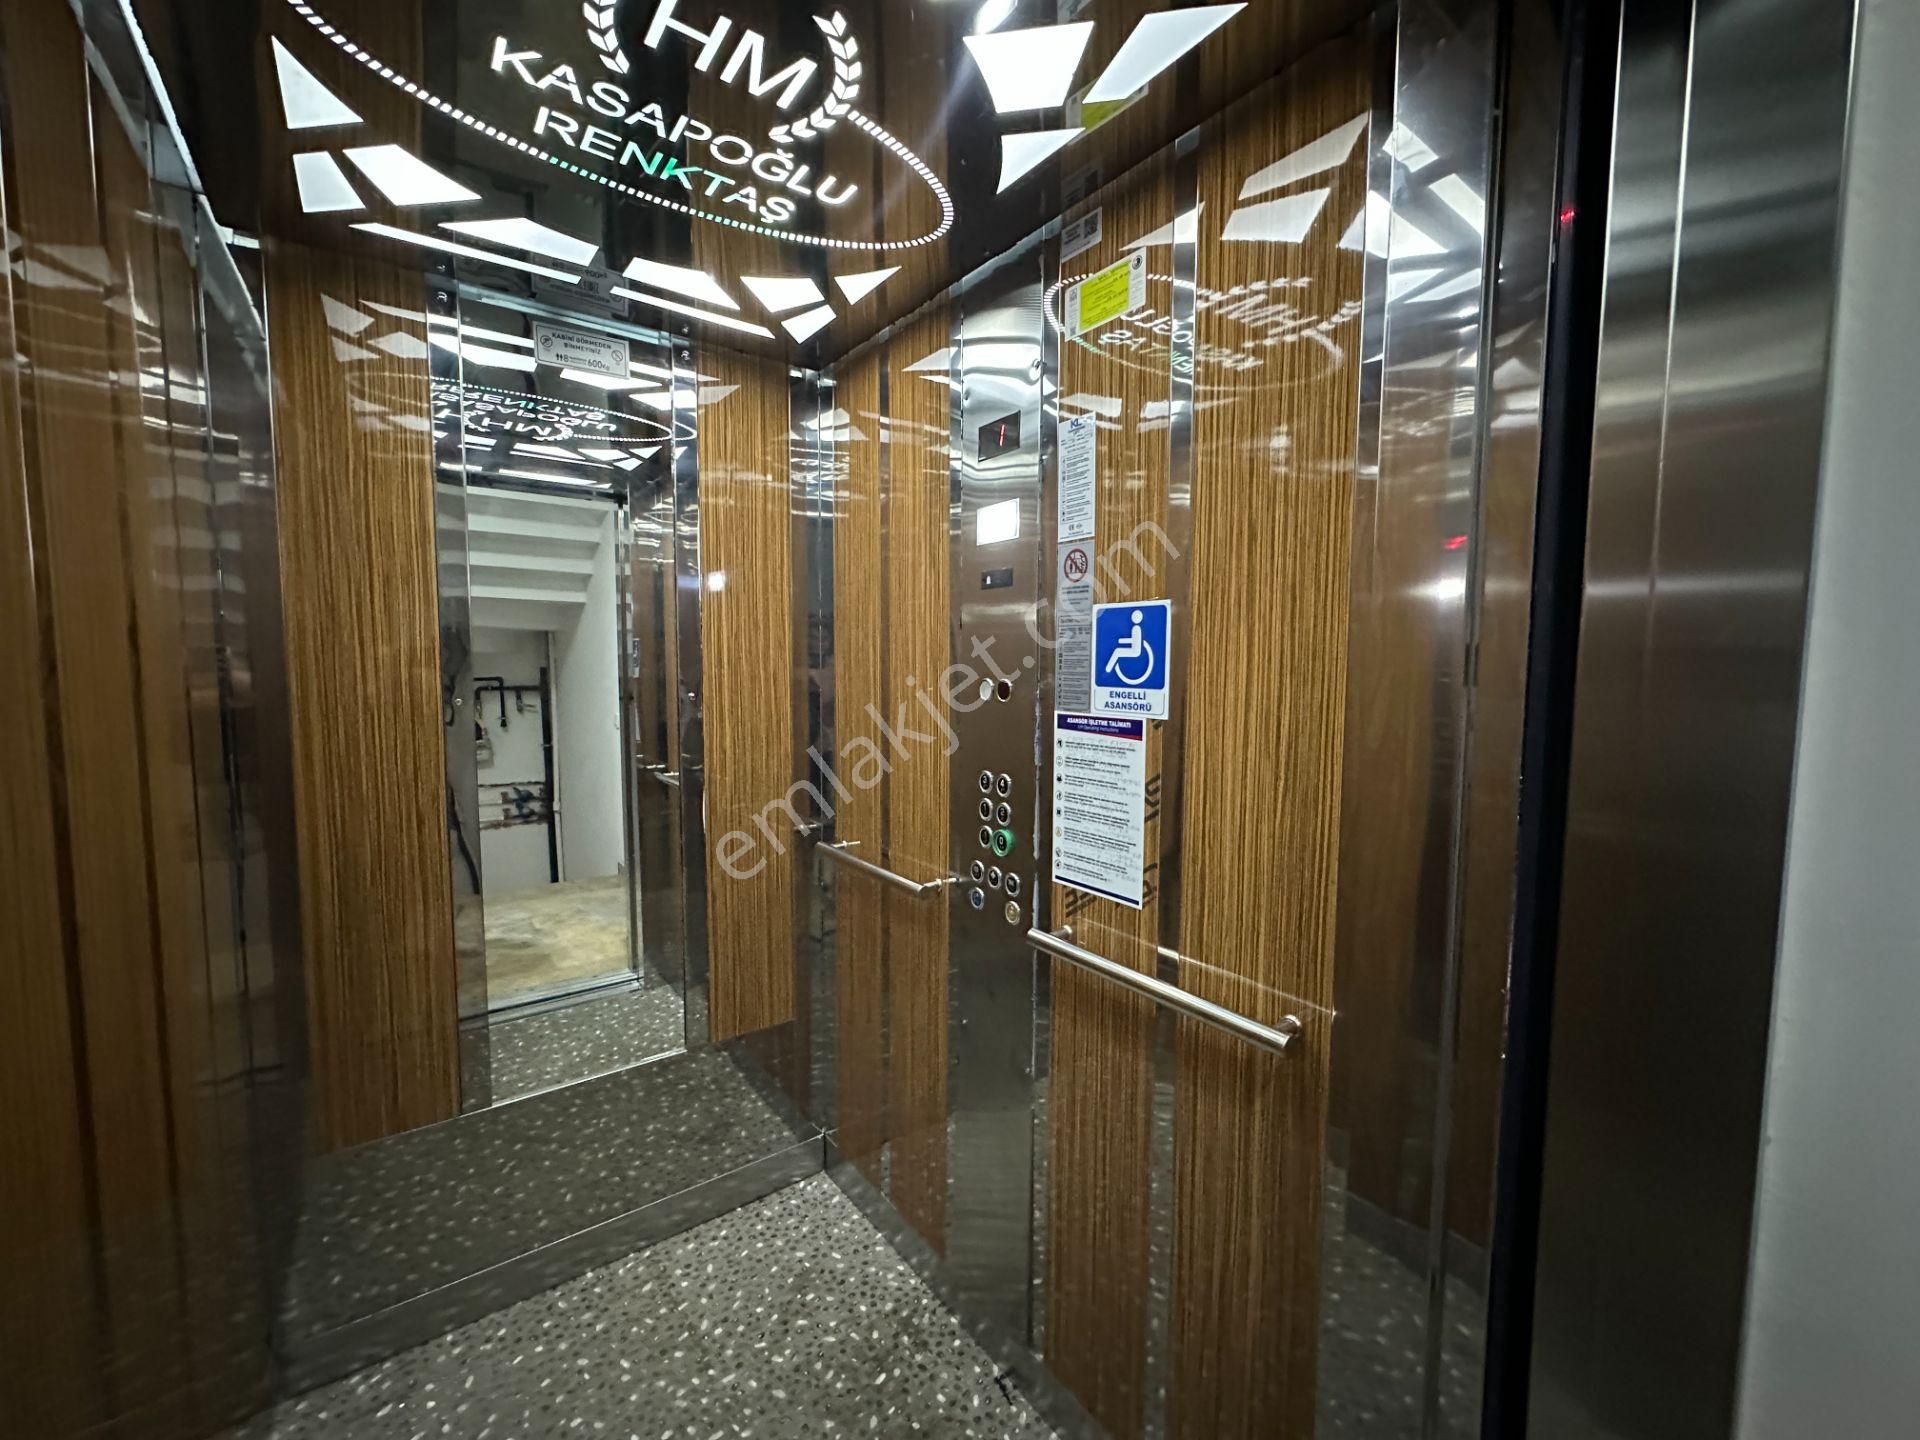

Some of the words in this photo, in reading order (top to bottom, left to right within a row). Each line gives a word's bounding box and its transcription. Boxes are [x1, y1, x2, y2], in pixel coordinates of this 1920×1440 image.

[643, 0, 818, 110] HM
[489, 36, 858, 206] KASAPOĞLU
[533, 106, 798, 224] RENKTAŞ
[551, 332, 575, 342] KABİNİ
[576, 336, 612, 350] GÖRMEDEN
[999, 424, 1006, 447] 1
[1104, 701, 1152, 712] ASANSÖRÜ
[1109, 690, 1146, 700] ENGELLİ
